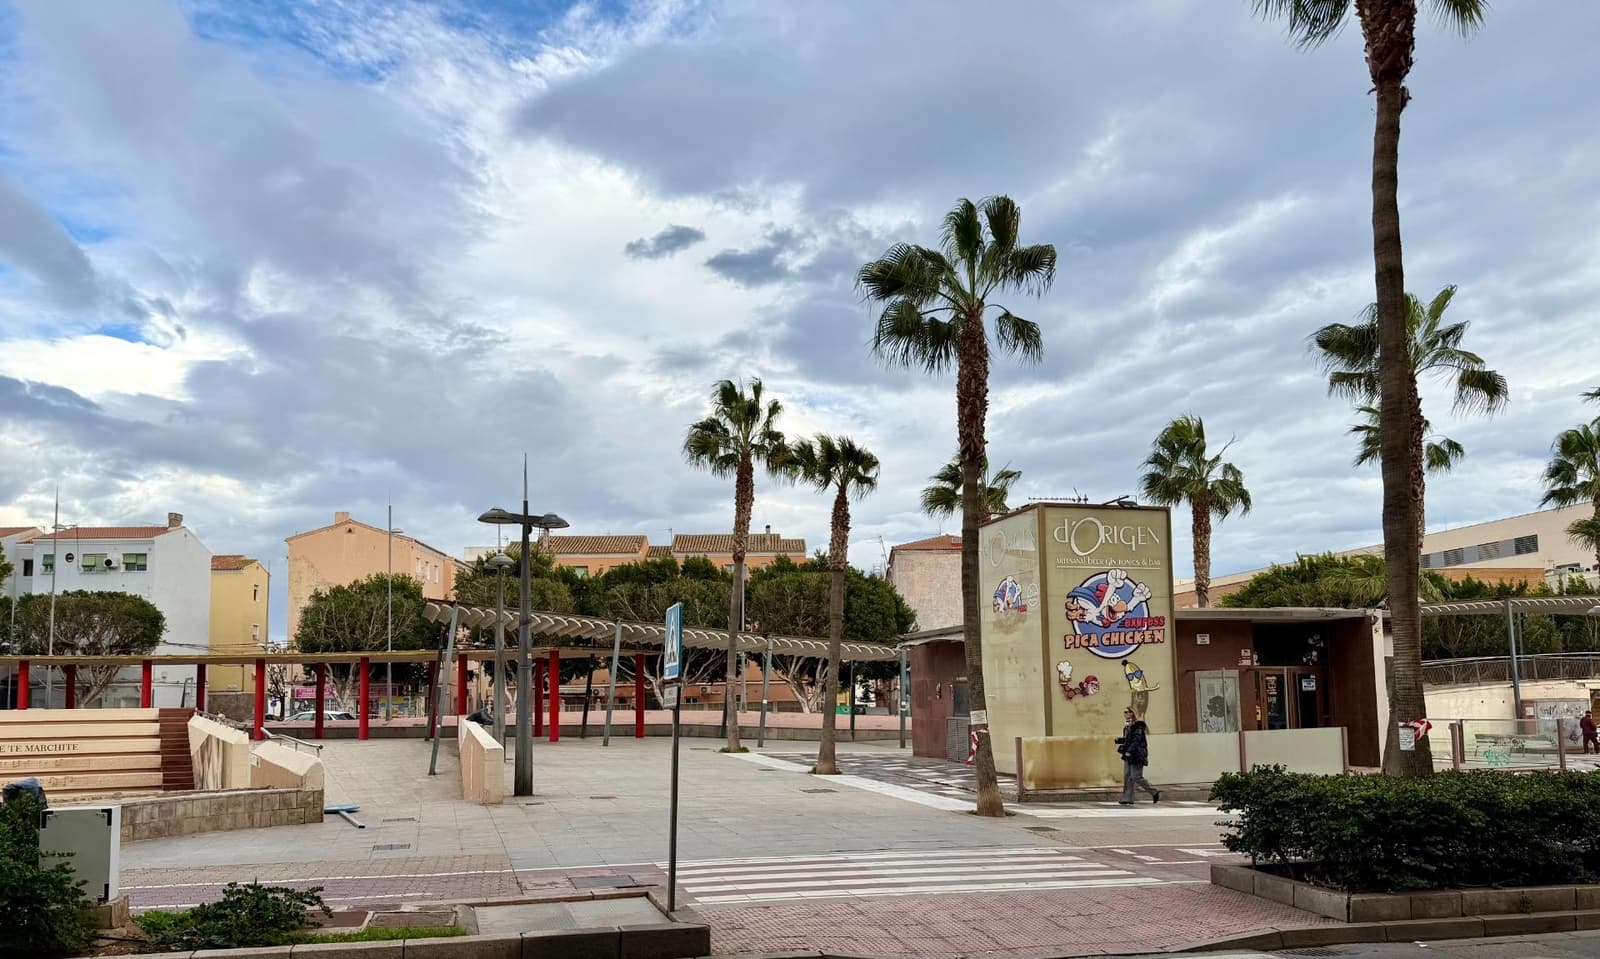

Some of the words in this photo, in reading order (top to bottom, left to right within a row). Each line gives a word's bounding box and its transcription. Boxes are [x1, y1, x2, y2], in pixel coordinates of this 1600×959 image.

[1064, 633, 1099, 649] PICA
[1101, 629, 1165, 646] CHICKEN
[8, 744, 22, 753] TE
[25, 743, 79, 752] MARCHITE
